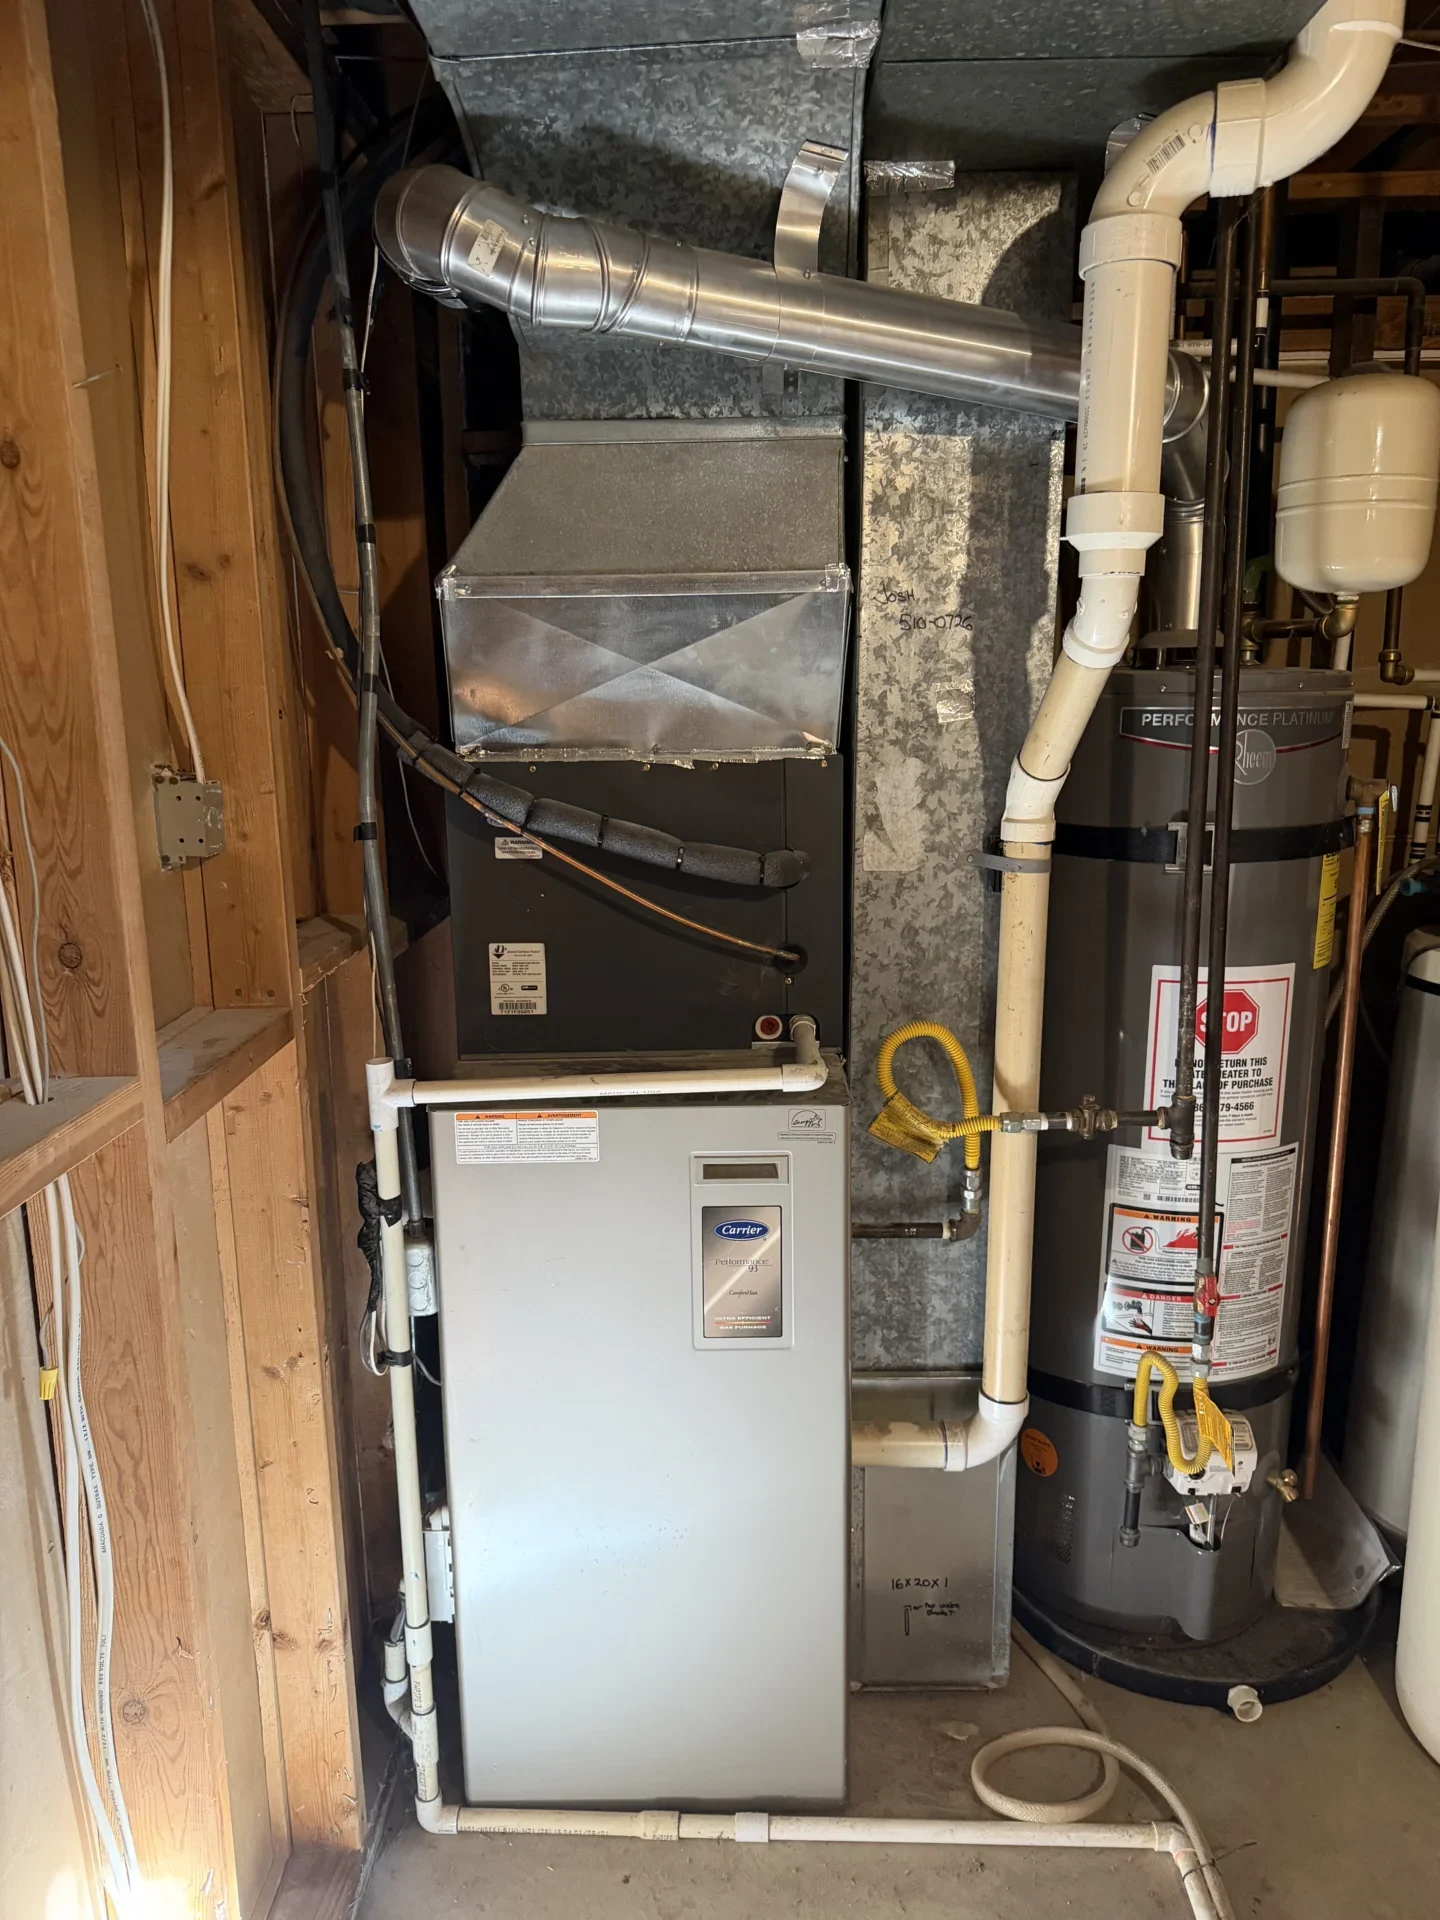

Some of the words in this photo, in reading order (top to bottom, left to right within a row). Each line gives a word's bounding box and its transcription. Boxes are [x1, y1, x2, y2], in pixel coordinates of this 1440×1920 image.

[873, 582, 915, 605] JOSH
[899, 613, 973, 631] 510-0726
[1141, 713, 1269, 726] PERFOMNCE
[1200, 1011, 1253, 1032] SOP
[1220, 1057, 1249, 1068] ETURN
[1250, 1056, 1268, 1066] THIS
[1222, 1069, 1249, 1079] EATER
[1252, 1068, 1262, 1078] TO
[1231, 1077, 1274, 1089] PURCHASE
[722, 1225, 763, 1235] Carrier
[1146, 1345, 1179, 1353] WARNING
